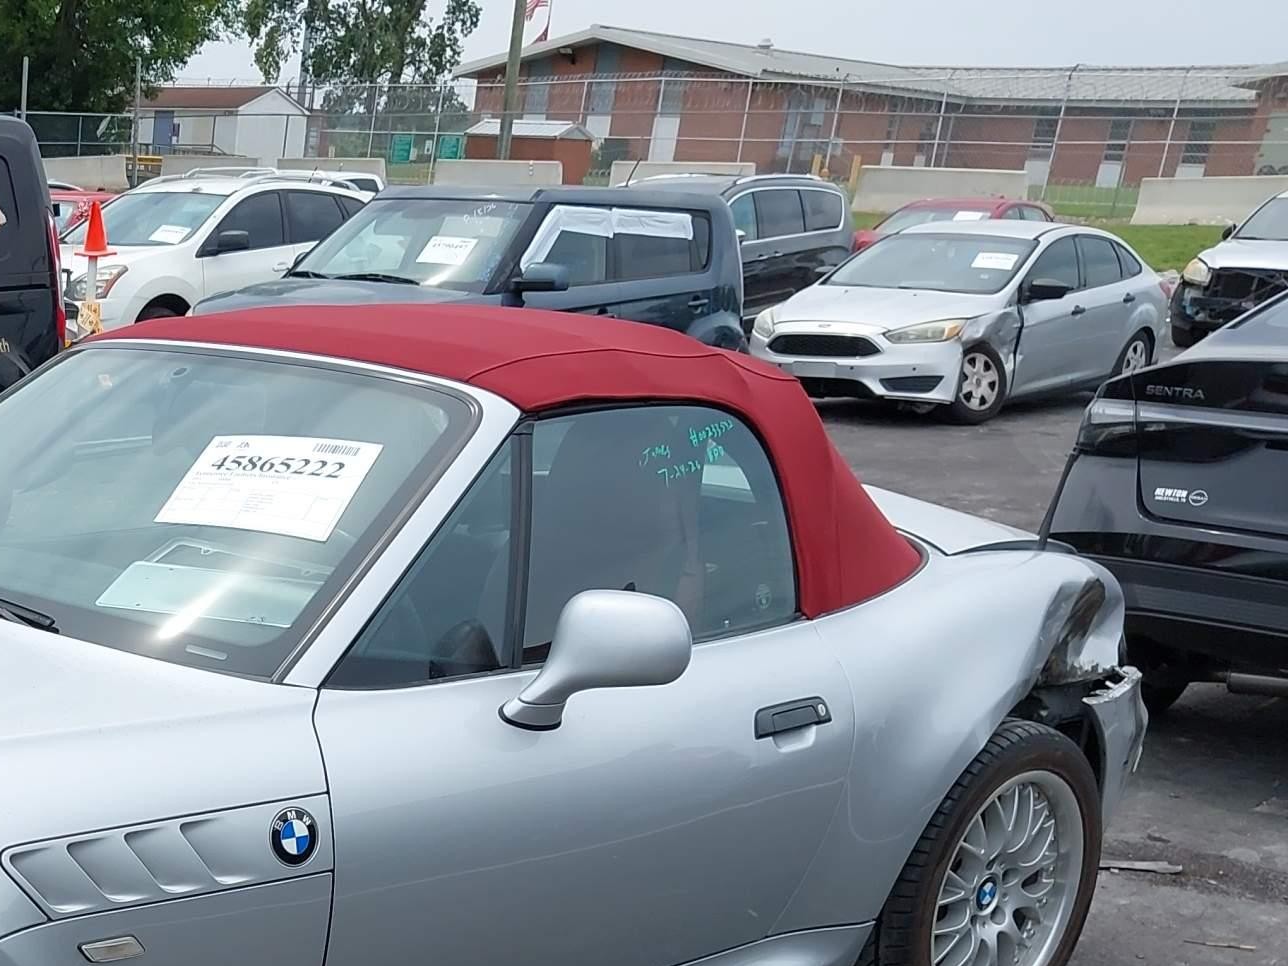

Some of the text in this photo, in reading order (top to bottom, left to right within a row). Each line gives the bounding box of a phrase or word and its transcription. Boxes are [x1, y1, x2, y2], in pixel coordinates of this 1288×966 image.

[1145, 384, 1205, 400] SENTRA
[211, 454, 346, 480] 45865222
[273, 810, 312, 831] BMW
